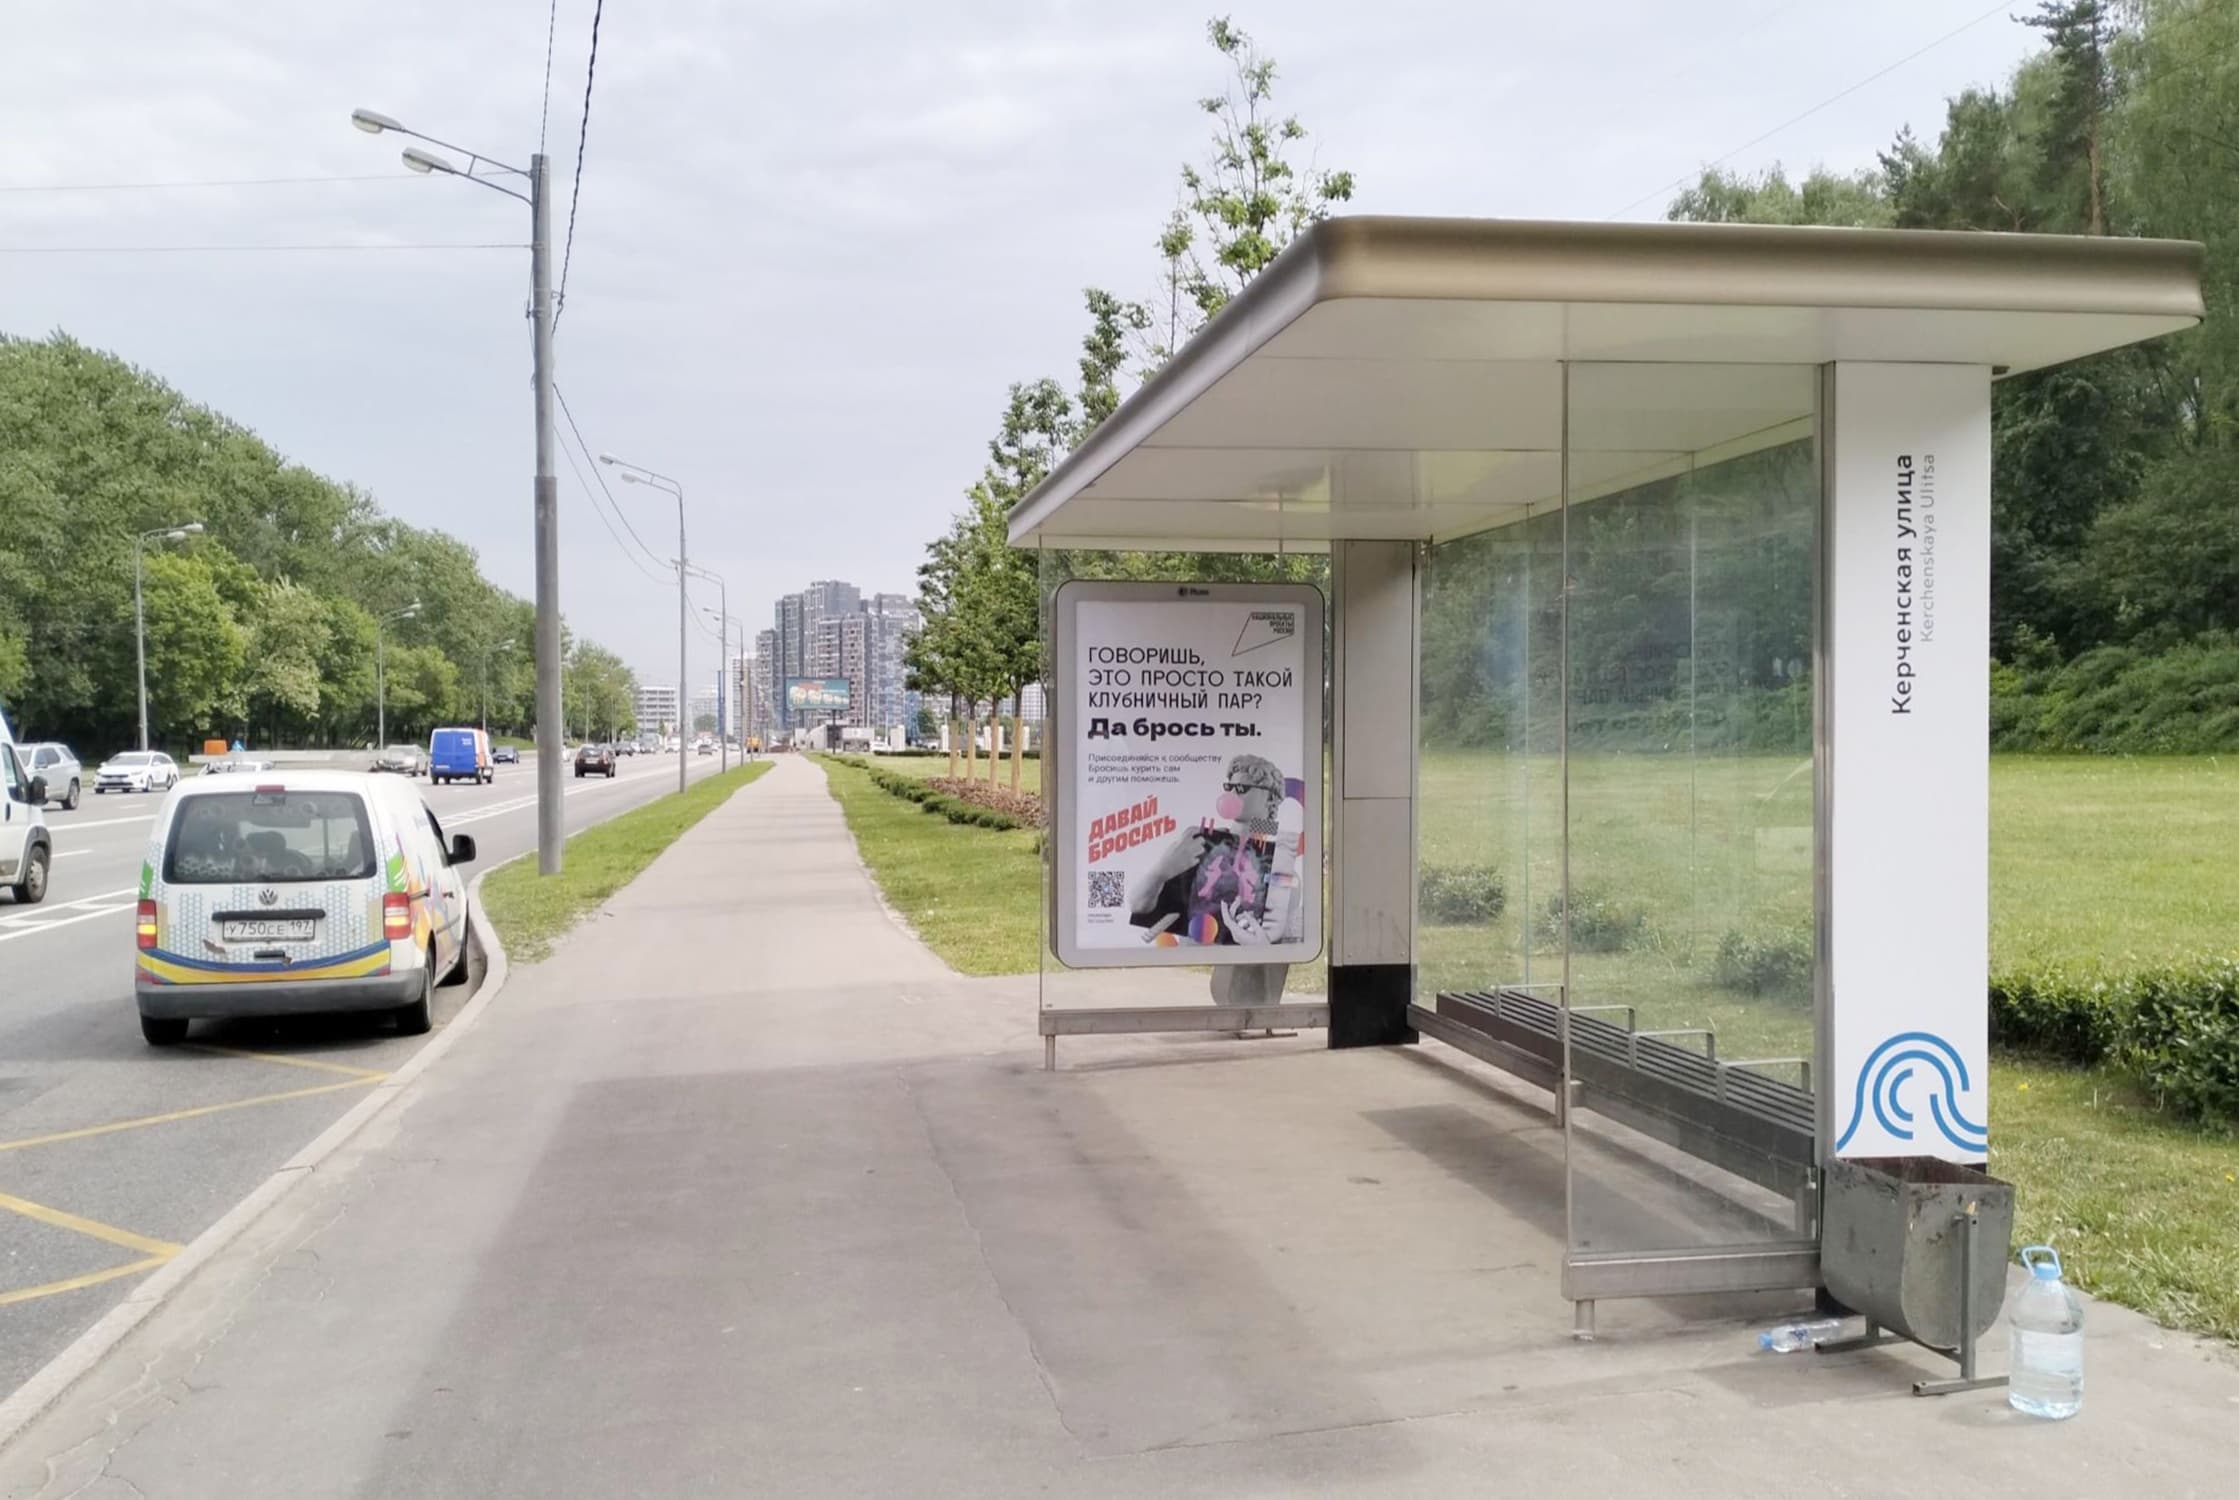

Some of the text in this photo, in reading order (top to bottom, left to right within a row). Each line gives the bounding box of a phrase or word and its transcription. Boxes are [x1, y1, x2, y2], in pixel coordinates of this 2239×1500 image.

[1919, 454, 1936, 642] Kerchenskaya Ulitsa
[1892, 455, 1917, 714] Керченская улица
[1088, 647, 1205, 666] ГОВОРИШЬ,
[1088, 668, 1293, 688] ЭТО ПРОСТО ТАКОЙ
[1218, 693, 1262, 709] ПАР?
[1087, 717, 1262, 741] Да брось ты.
[1088, 753, 1159, 763] Присоединяйся
[1169, 753, 1222, 763] сообществу
[1088, 764, 1128, 773] Бросишь
[1131, 765, 1161, 773] курить
[1096, 775, 1128, 784] другим
[1088, 794, 1158, 844] ДАВАЙ
[1088, 815, 1177, 864] БРОСАТЬ
